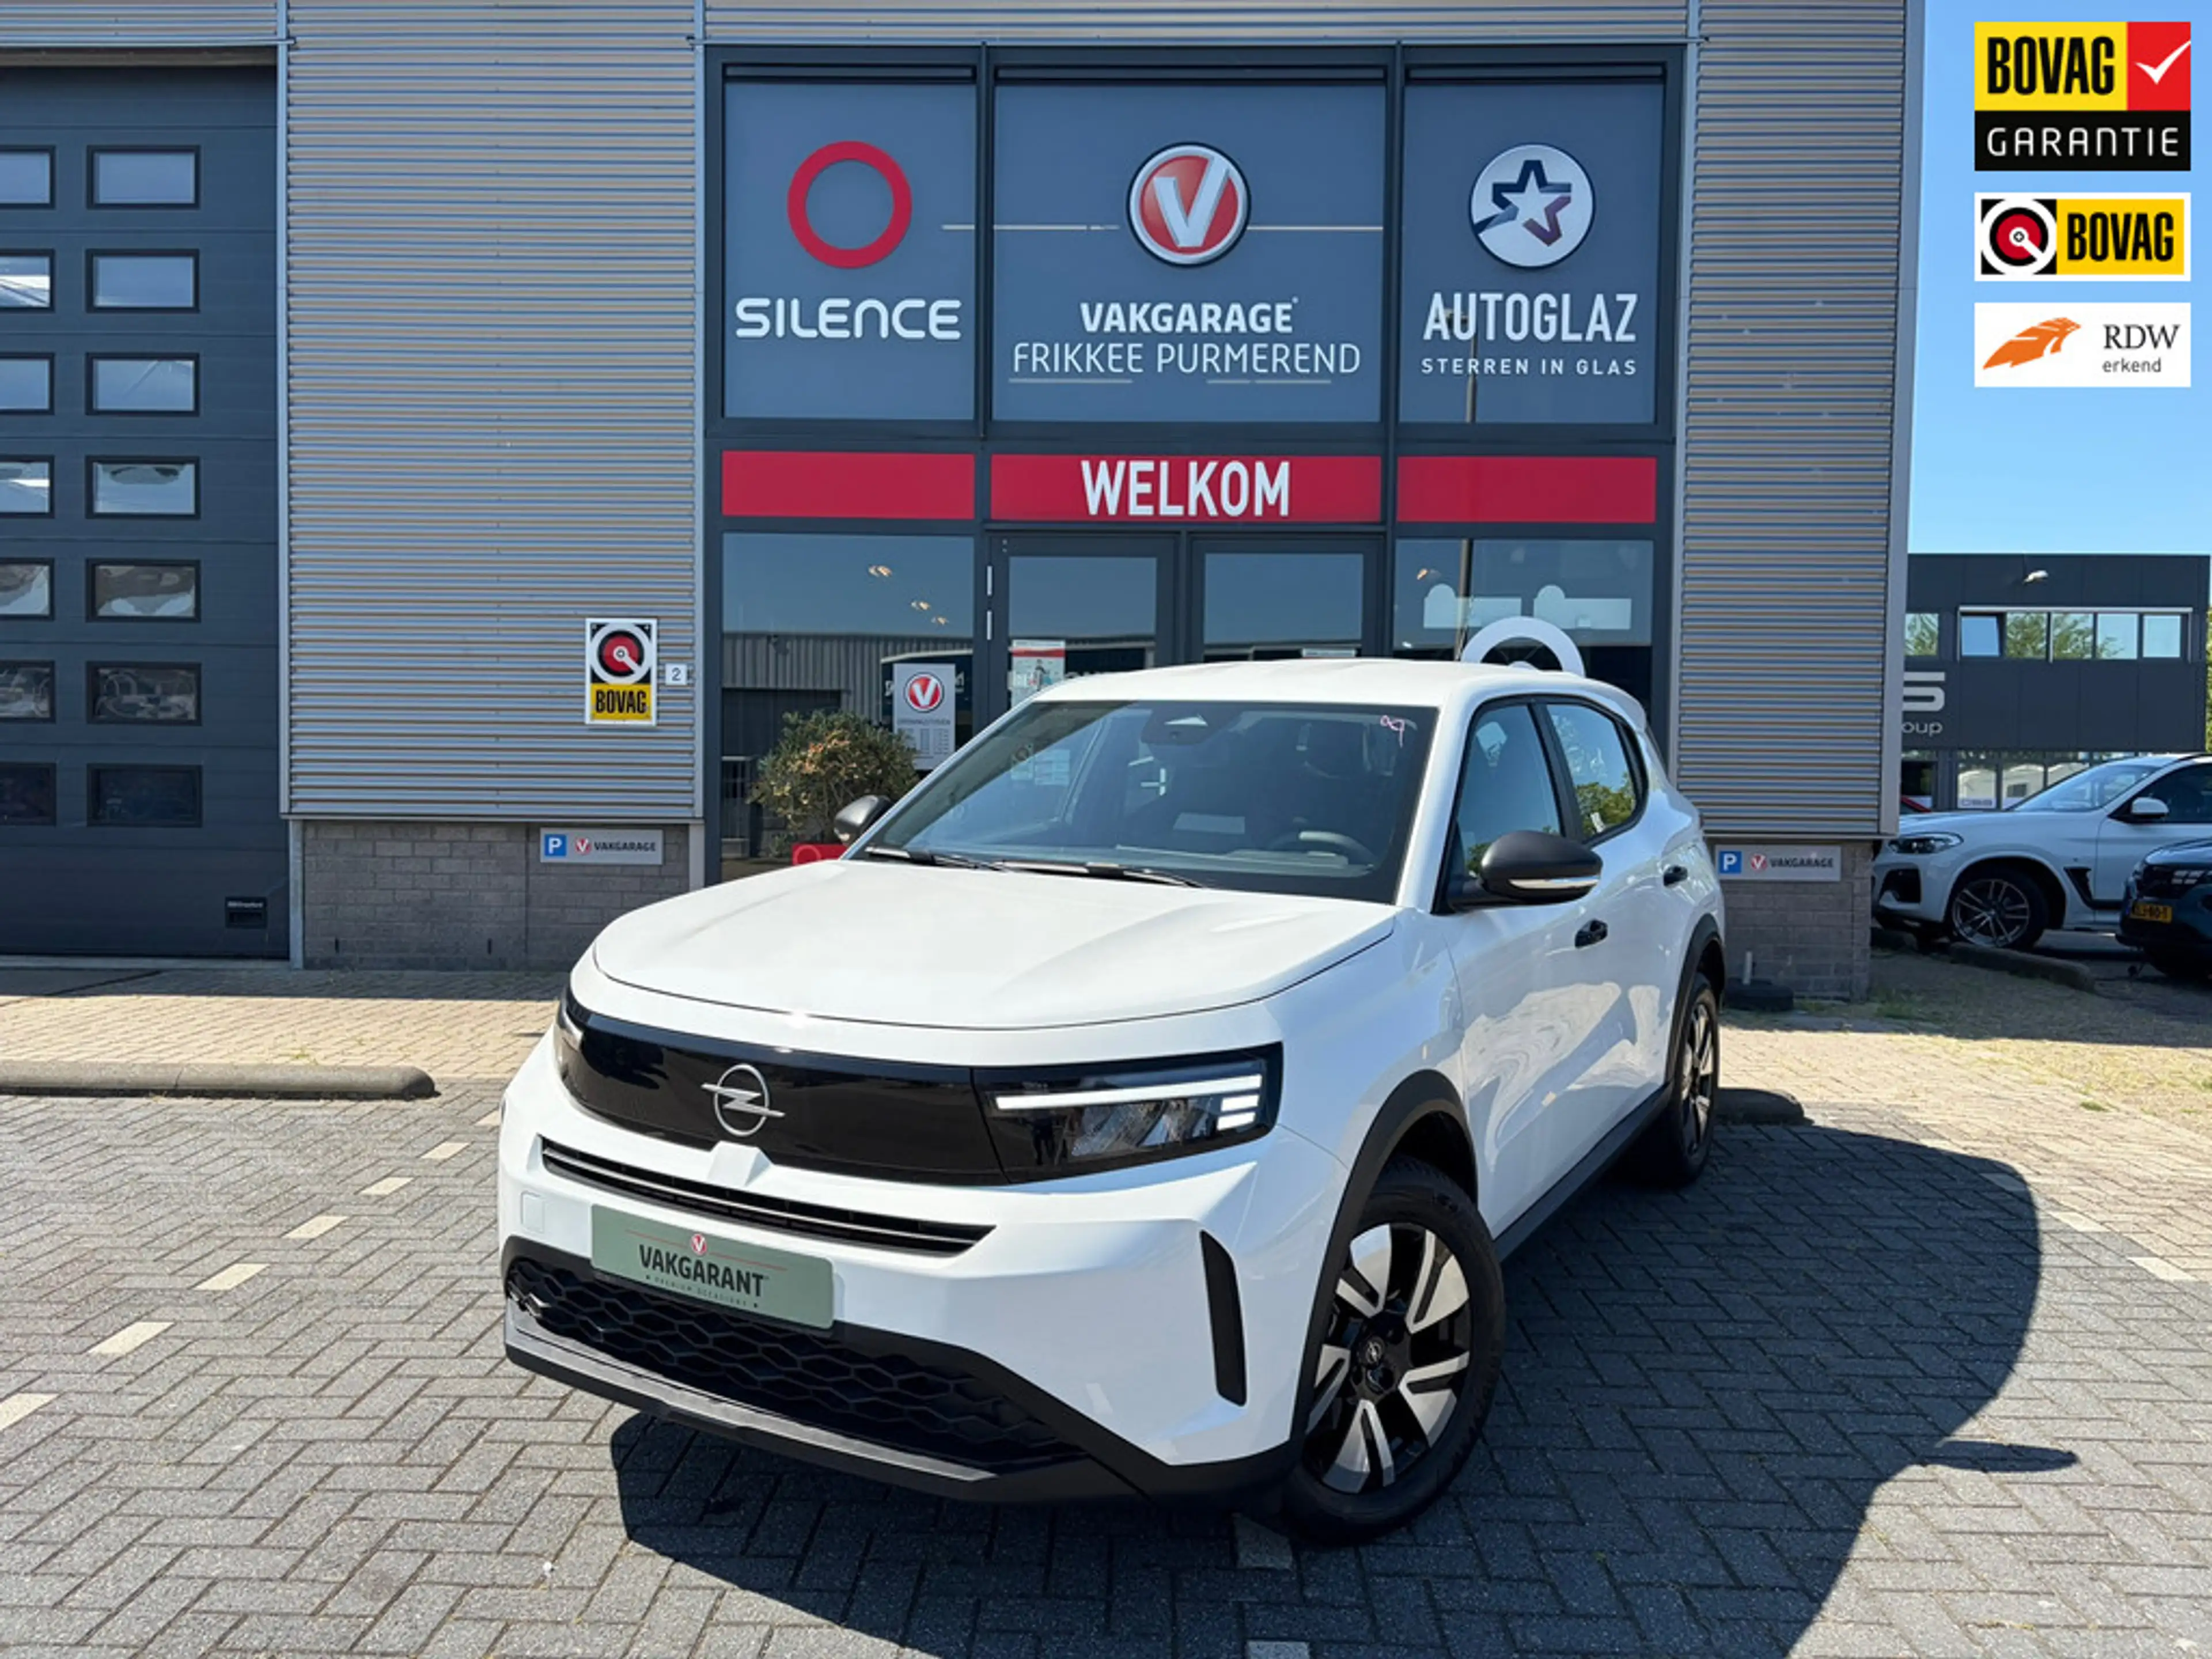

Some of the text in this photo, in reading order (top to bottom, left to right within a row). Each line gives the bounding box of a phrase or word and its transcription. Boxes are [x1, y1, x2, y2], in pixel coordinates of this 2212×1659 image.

[736, 298, 961, 339] SILENCE
[1080, 302, 1293, 334] VAKGARAGE
[1423, 292, 1638, 342] AUTOGLAZ
[1013, 343, 1361, 374] FRIKKEE PURMEREND
[1422, 358, 1636, 376] STERREN IN GLAS
[1081, 460, 1290, 517] WELKOM
[672, 667, 680, 681] 2
[595, 689, 647, 715] BOVAG
[549, 837, 563, 854] P
[594, 840, 657, 852] VAKGARAGE
[1723, 854, 1737, 871] P
[639, 1243, 764, 1298] VAKGARANT
